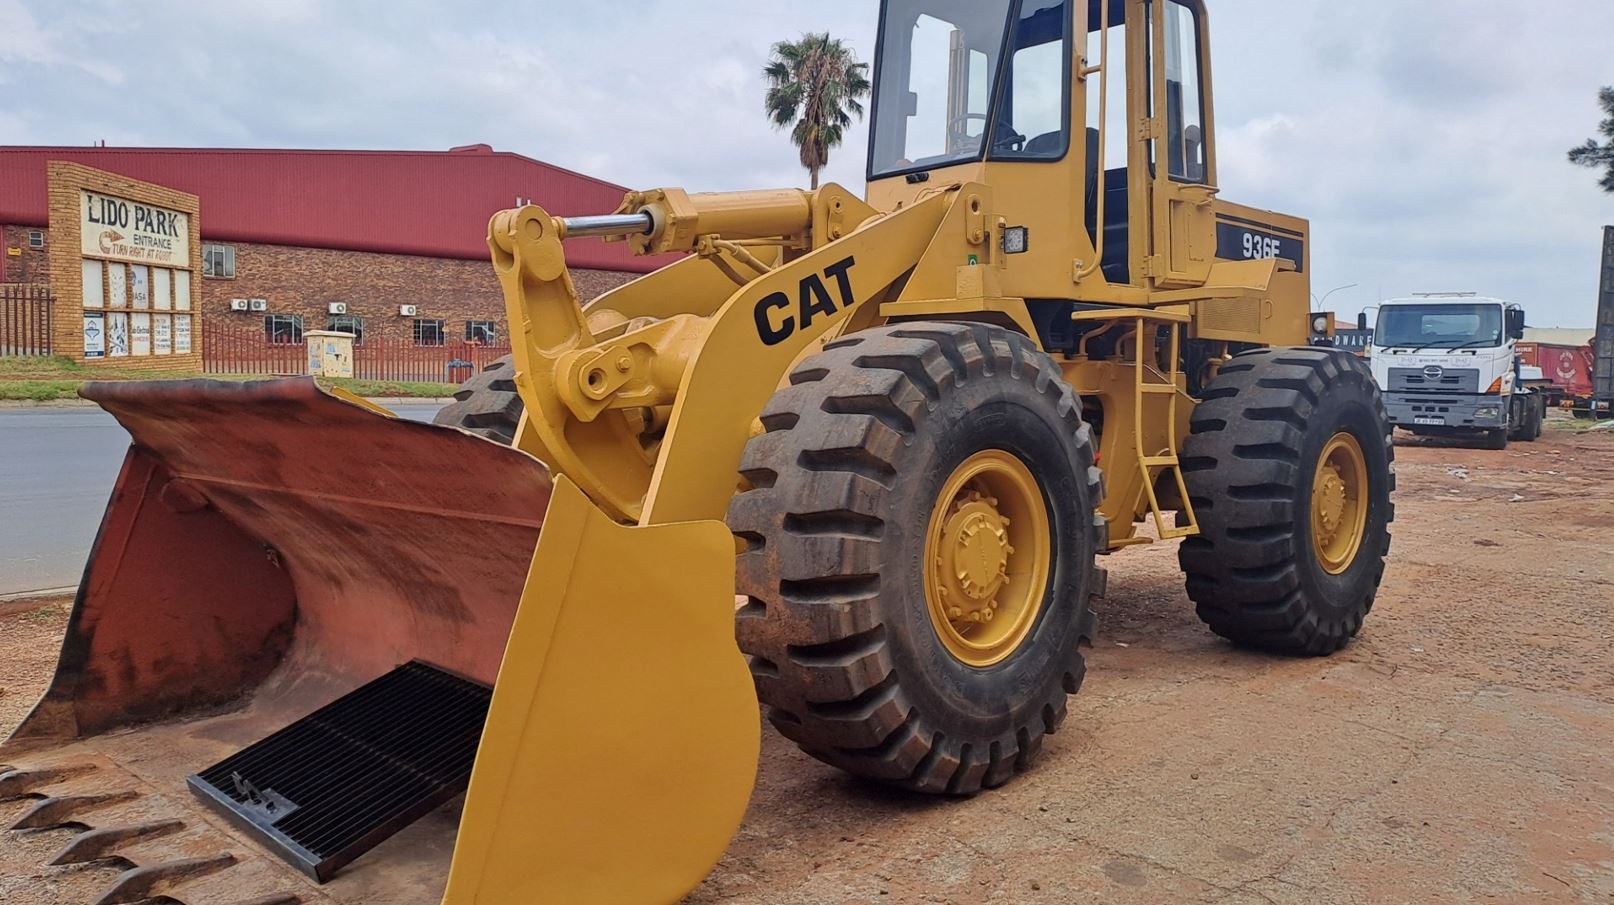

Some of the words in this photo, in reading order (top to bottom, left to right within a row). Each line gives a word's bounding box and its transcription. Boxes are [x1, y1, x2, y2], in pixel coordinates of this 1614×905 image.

[87, 194, 129, 228] LIDO
[134, 205, 180, 238] PARK
[133, 233, 172, 250] ENTRANCE
[112, 243, 129, 256] TURN
[129, 246, 146, 259] RIGHT
[147, 248, 155, 259] AT
[754, 255, 855, 346] CAT
[1314, 335, 1373, 347] DWARE
